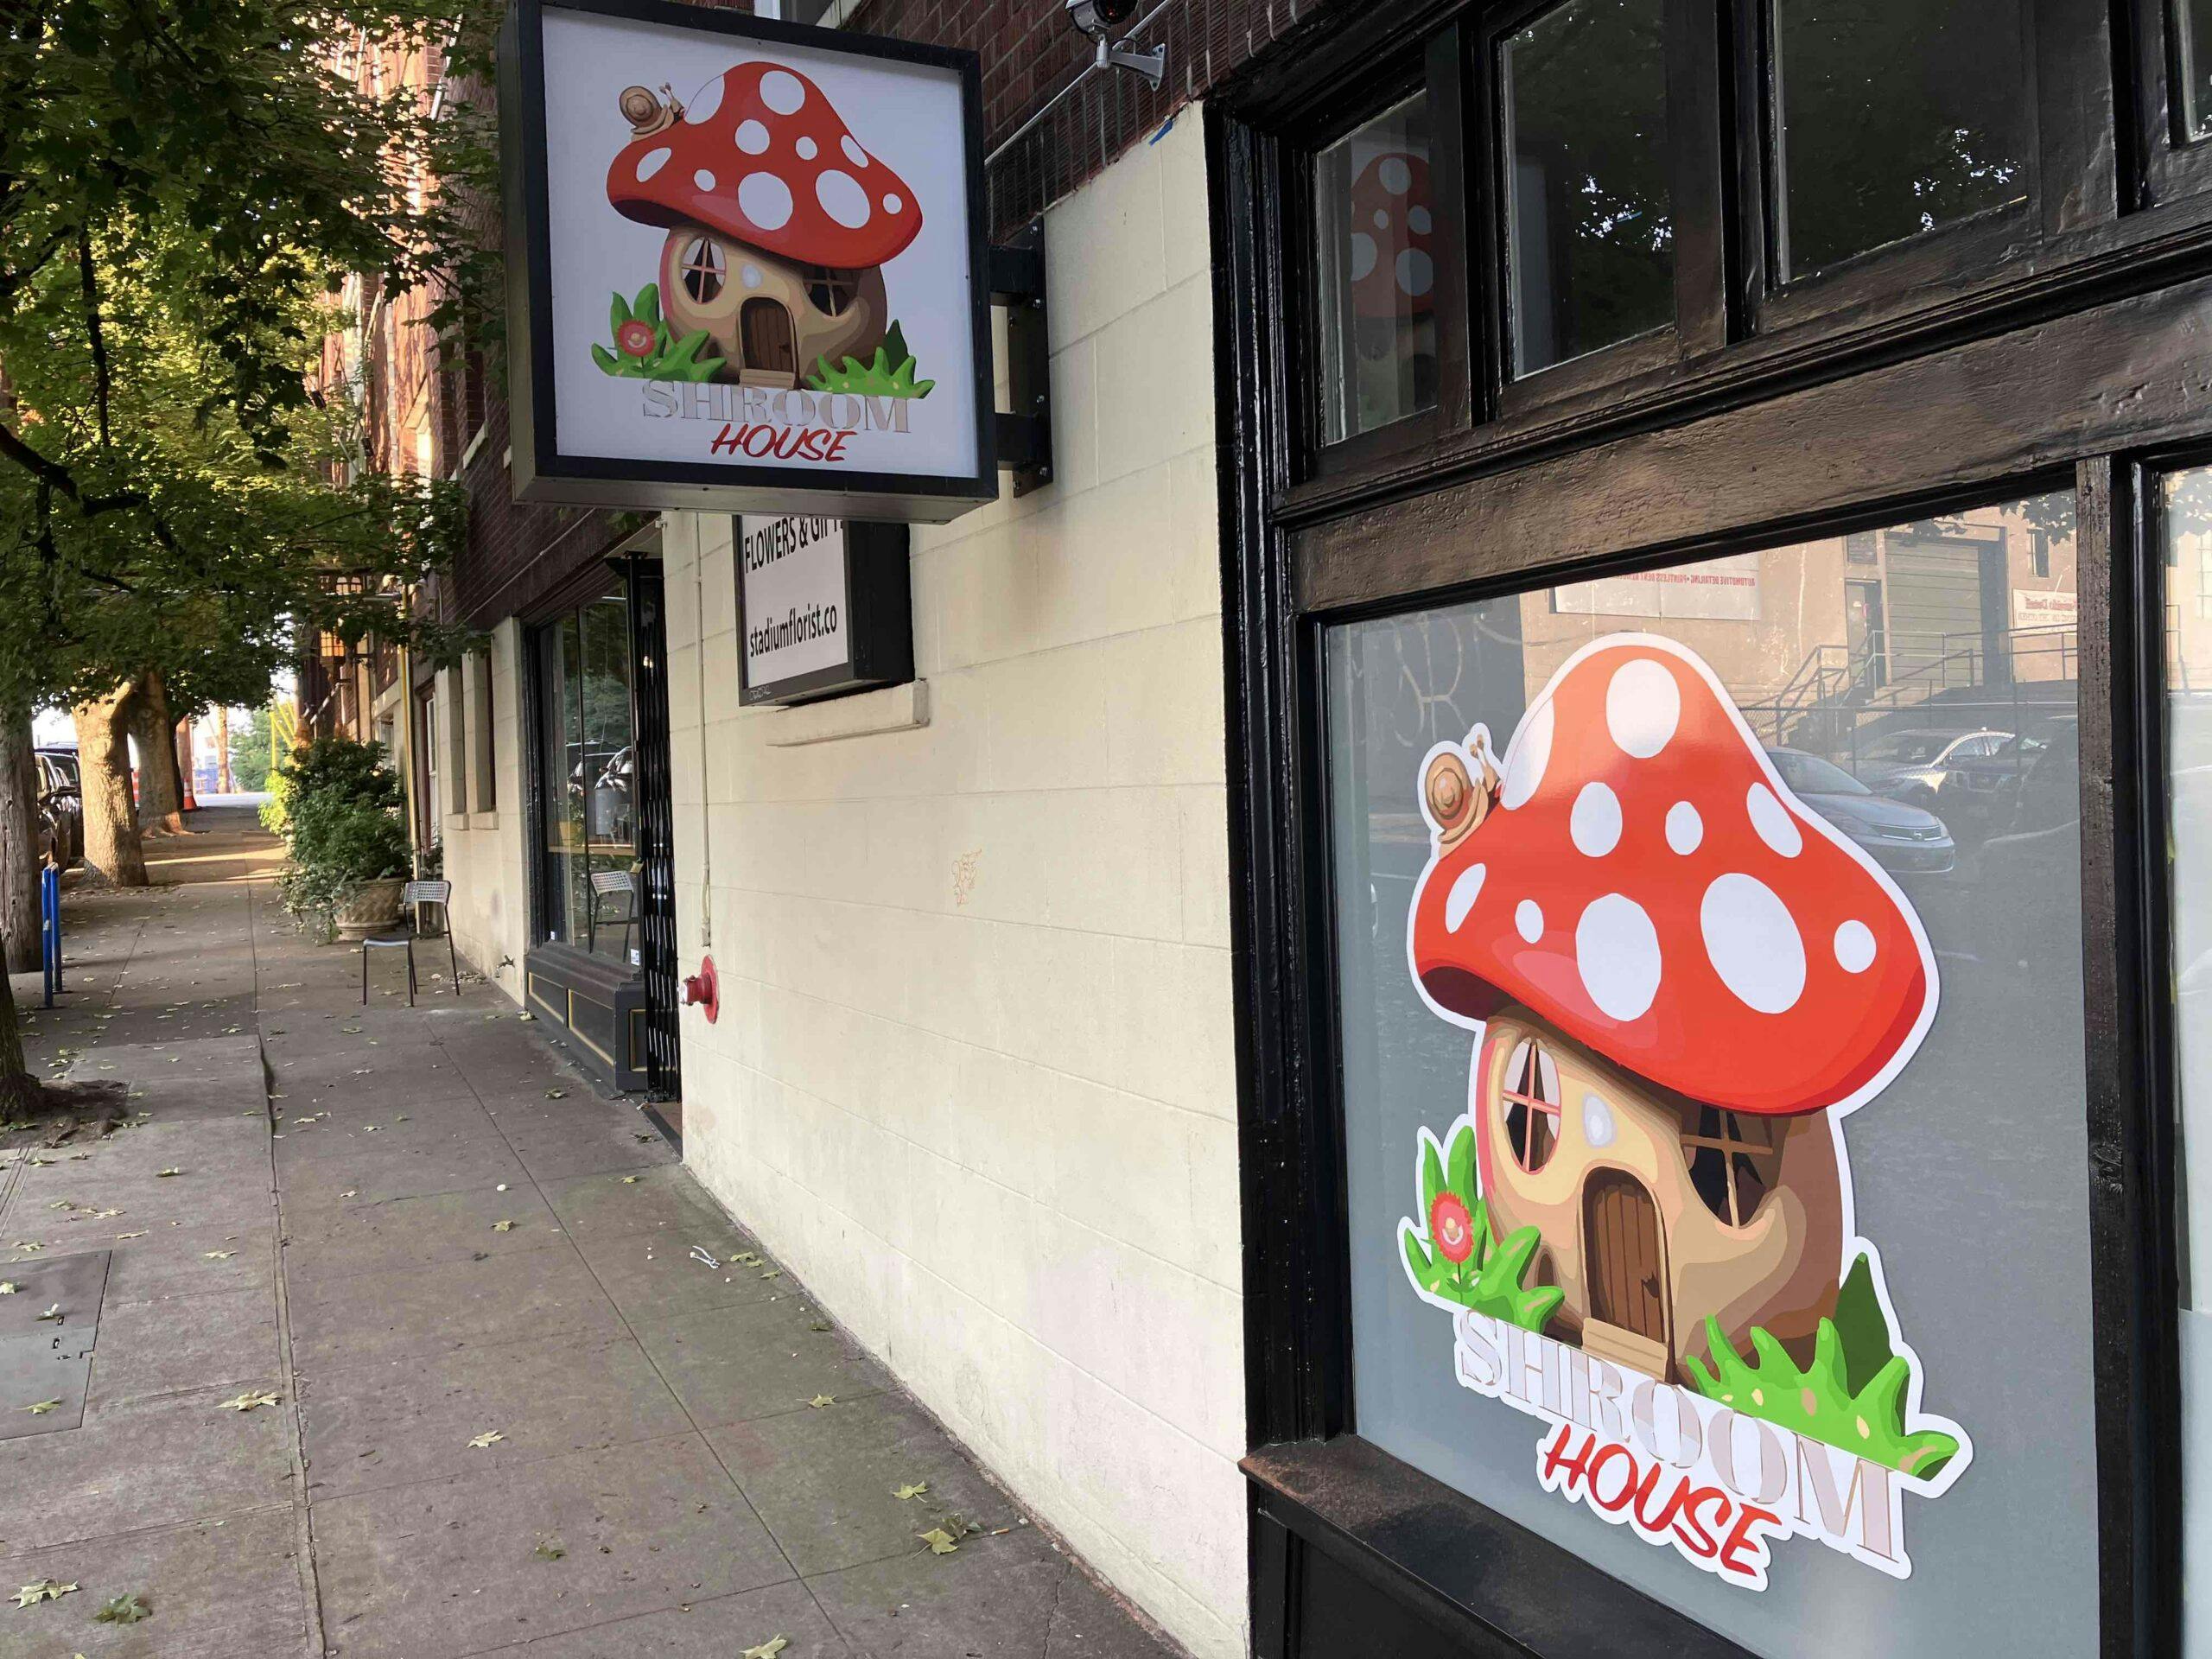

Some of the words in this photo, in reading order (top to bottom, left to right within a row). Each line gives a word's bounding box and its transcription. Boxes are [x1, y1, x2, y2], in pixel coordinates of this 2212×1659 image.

[642, 378, 911, 433] SHROOM
[710, 423, 857, 462] HOUSE
[745, 517, 796, 574] FLOWERS
[799, 517, 808, 549] &
[749, 604, 837, 658] stadiumflorist.co
[1460, 1309, 1899, 1563] SHROOM
[1544, 1423, 1782, 1577] HOUSE
